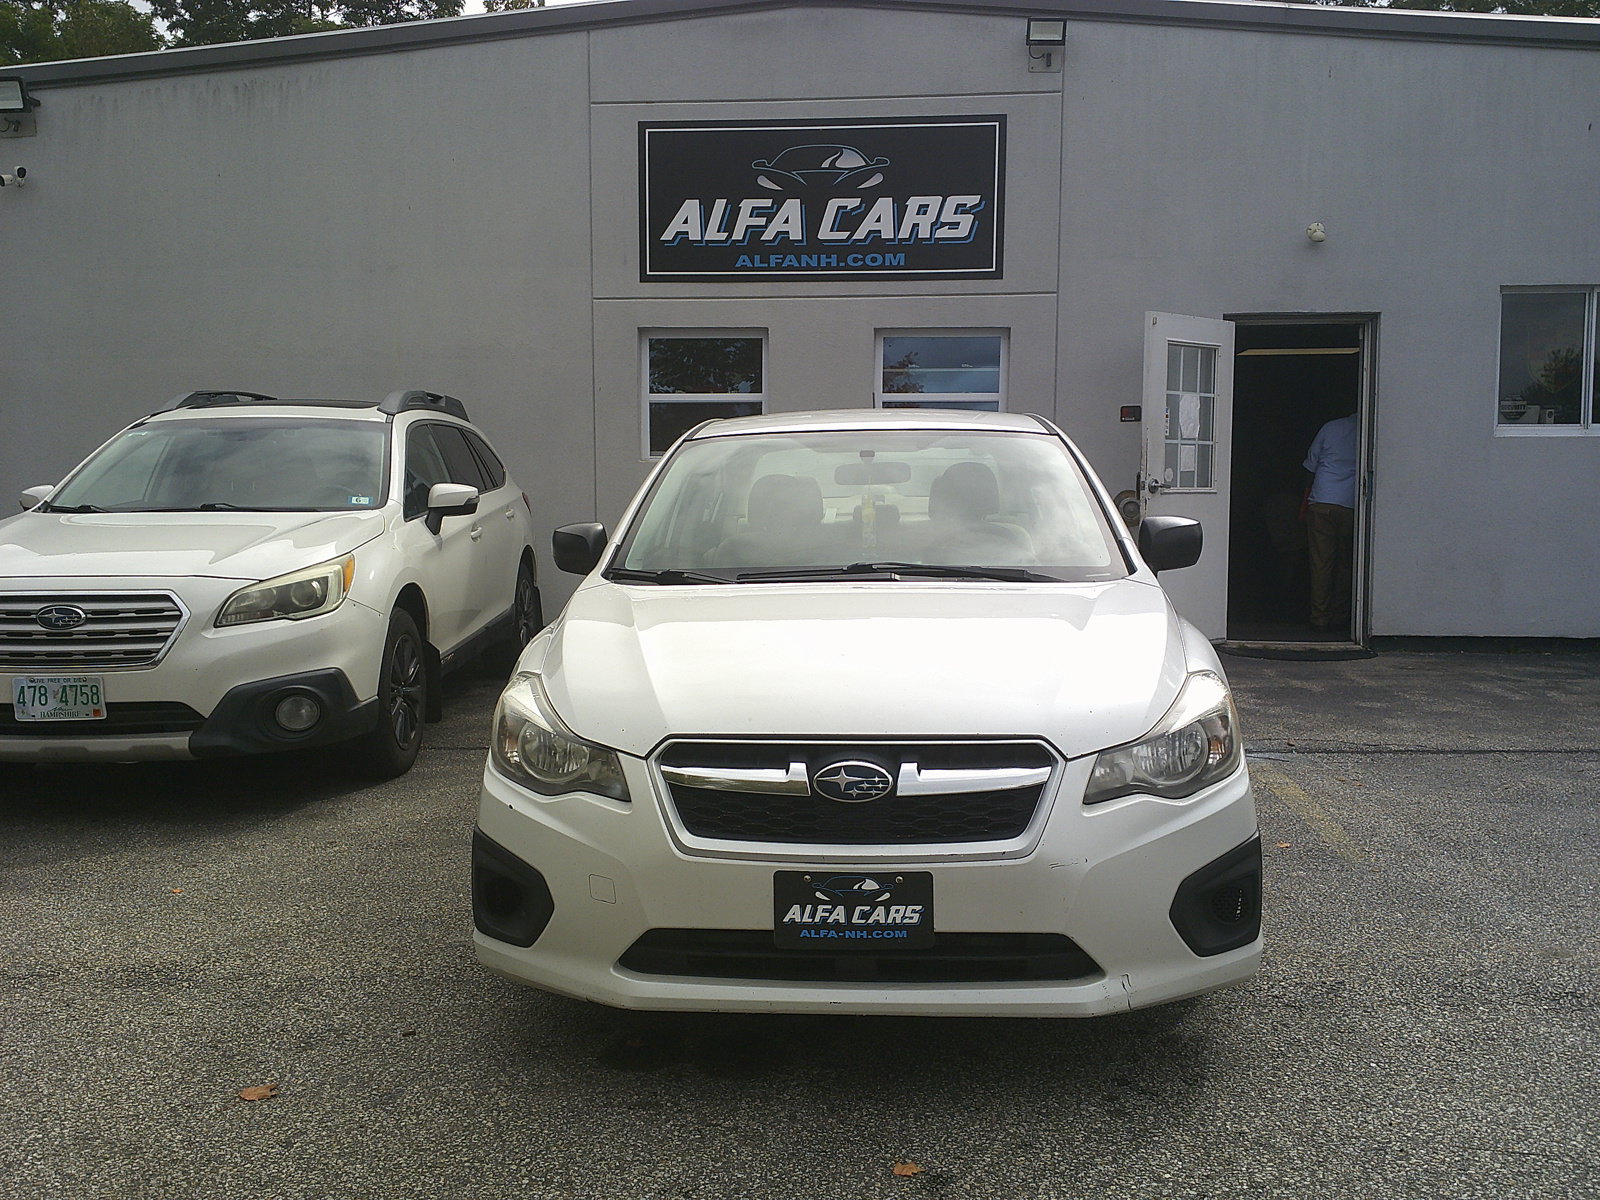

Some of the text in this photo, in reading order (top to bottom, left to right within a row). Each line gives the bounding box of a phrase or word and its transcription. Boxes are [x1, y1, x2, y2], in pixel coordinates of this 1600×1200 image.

[660, 195, 985, 245] ALFA CARS
[735, 252, 906, 268] ALFANH.COM
[17, 684, 100, 707] 478 4758
[783, 904, 924, 926] ALFA CARS
[799, 929, 908, 939] ALFA-NH.COM
